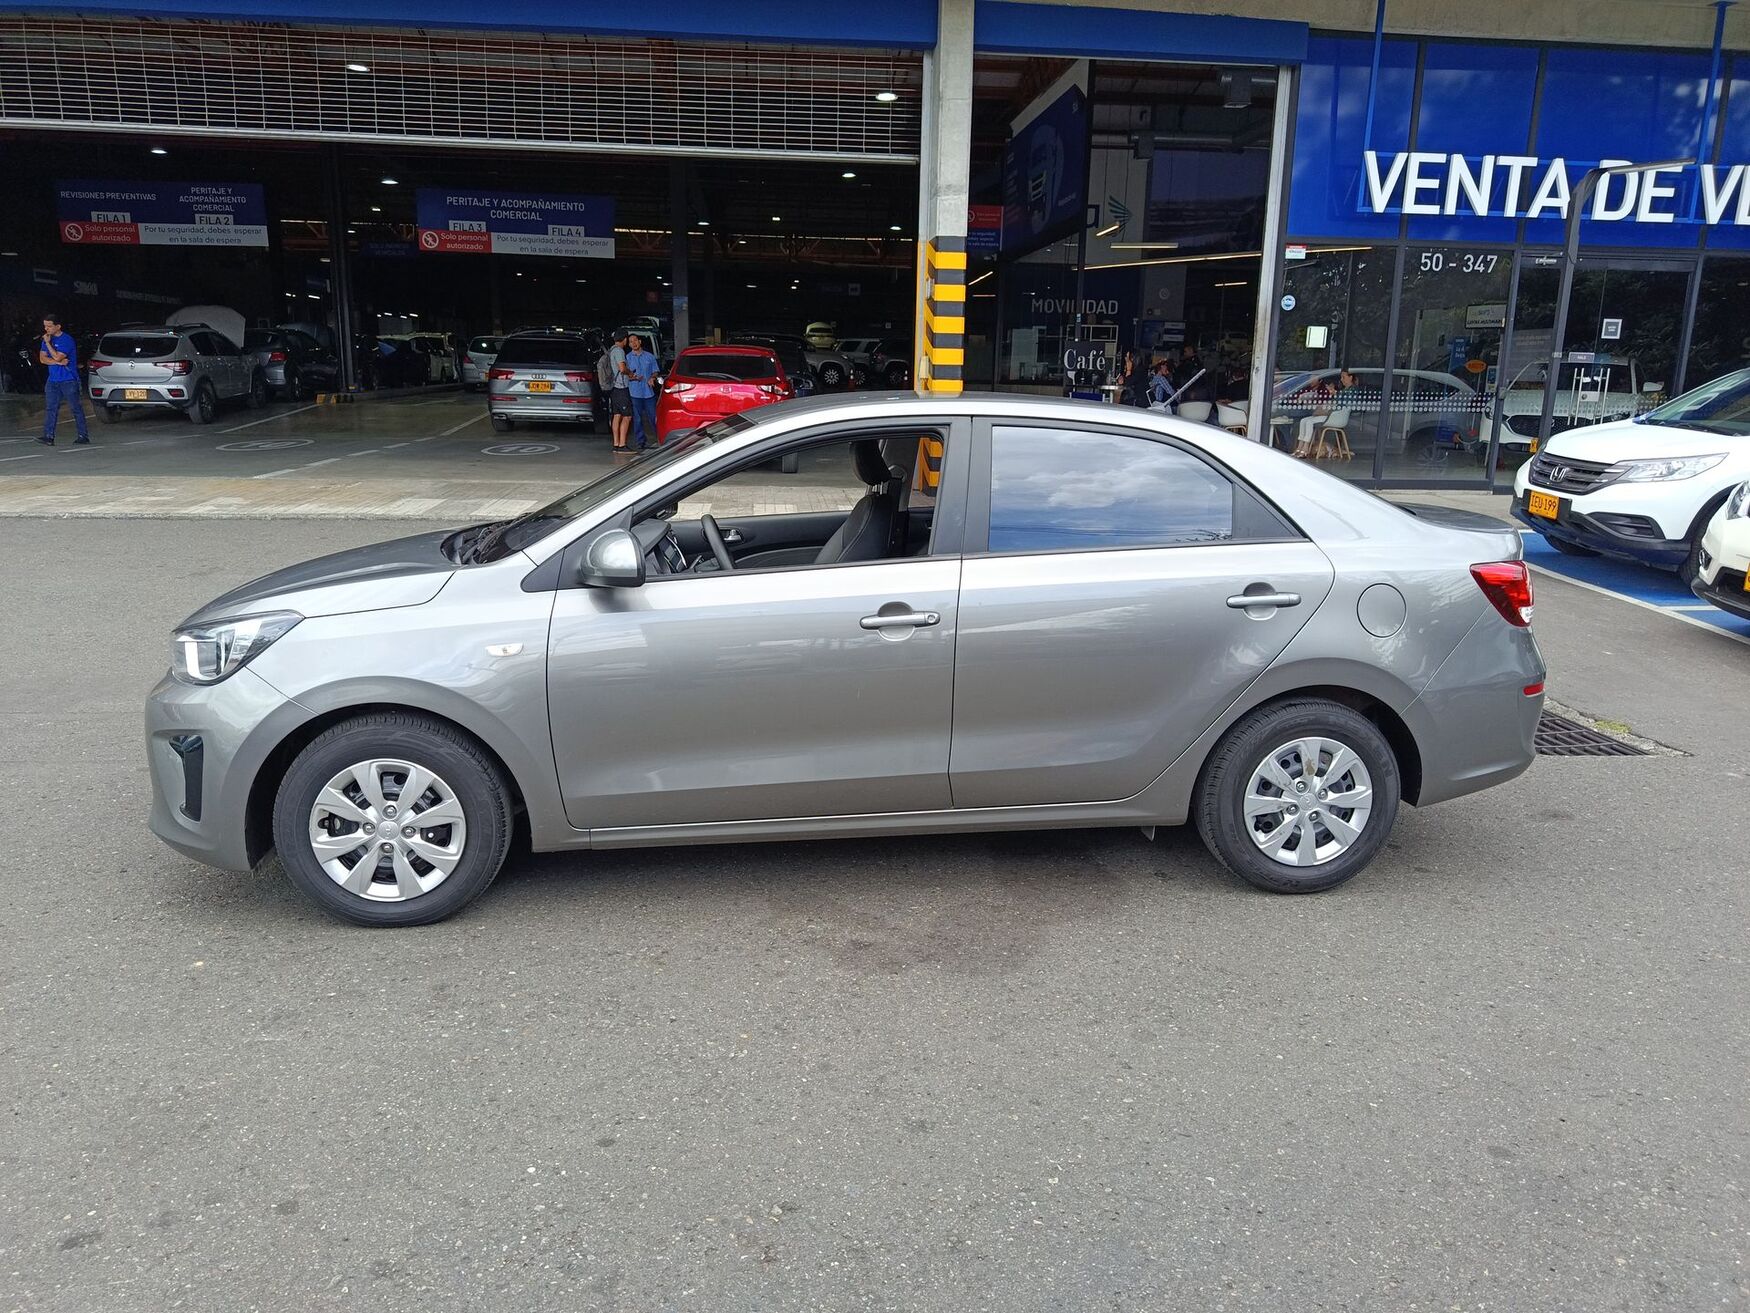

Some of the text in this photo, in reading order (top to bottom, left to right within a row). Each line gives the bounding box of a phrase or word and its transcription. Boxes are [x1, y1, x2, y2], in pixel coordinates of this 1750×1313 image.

[191, 187, 226, 195] PERITAJE
[1364, 150, 1571, 220] VENTA
[1591, 159, 1684, 224] DE
[60, 190, 157, 201] REVISIONES PREVENTIVAS
[179, 194, 247, 204] ACOMPAÑAMIENTO
[192, 204, 235, 212] COMERCIAL
[446, 196, 585, 211] PERITAJE Y ACOMPAÑAMIENTO
[97, 214, 119, 223] FILA
[490, 210, 542, 221] COMERCIAL
[199, 216, 230, 225] FILA 2
[103, 225, 135, 234] personal
[208, 227, 231, 235] debes
[453, 223, 482, 232] FILA 3
[552, 227, 581, 237] FILA 4
[91, 234, 131, 242] autorizado
[440, 232, 488, 243] Solo personal
[582, 239, 609, 247] esperar
[564, 248, 588, 256] espera
[1420, 253, 1444, 272] 50
[1462, 254, 1498, 274] 347
[1063, 348, 1106, 371] Café
